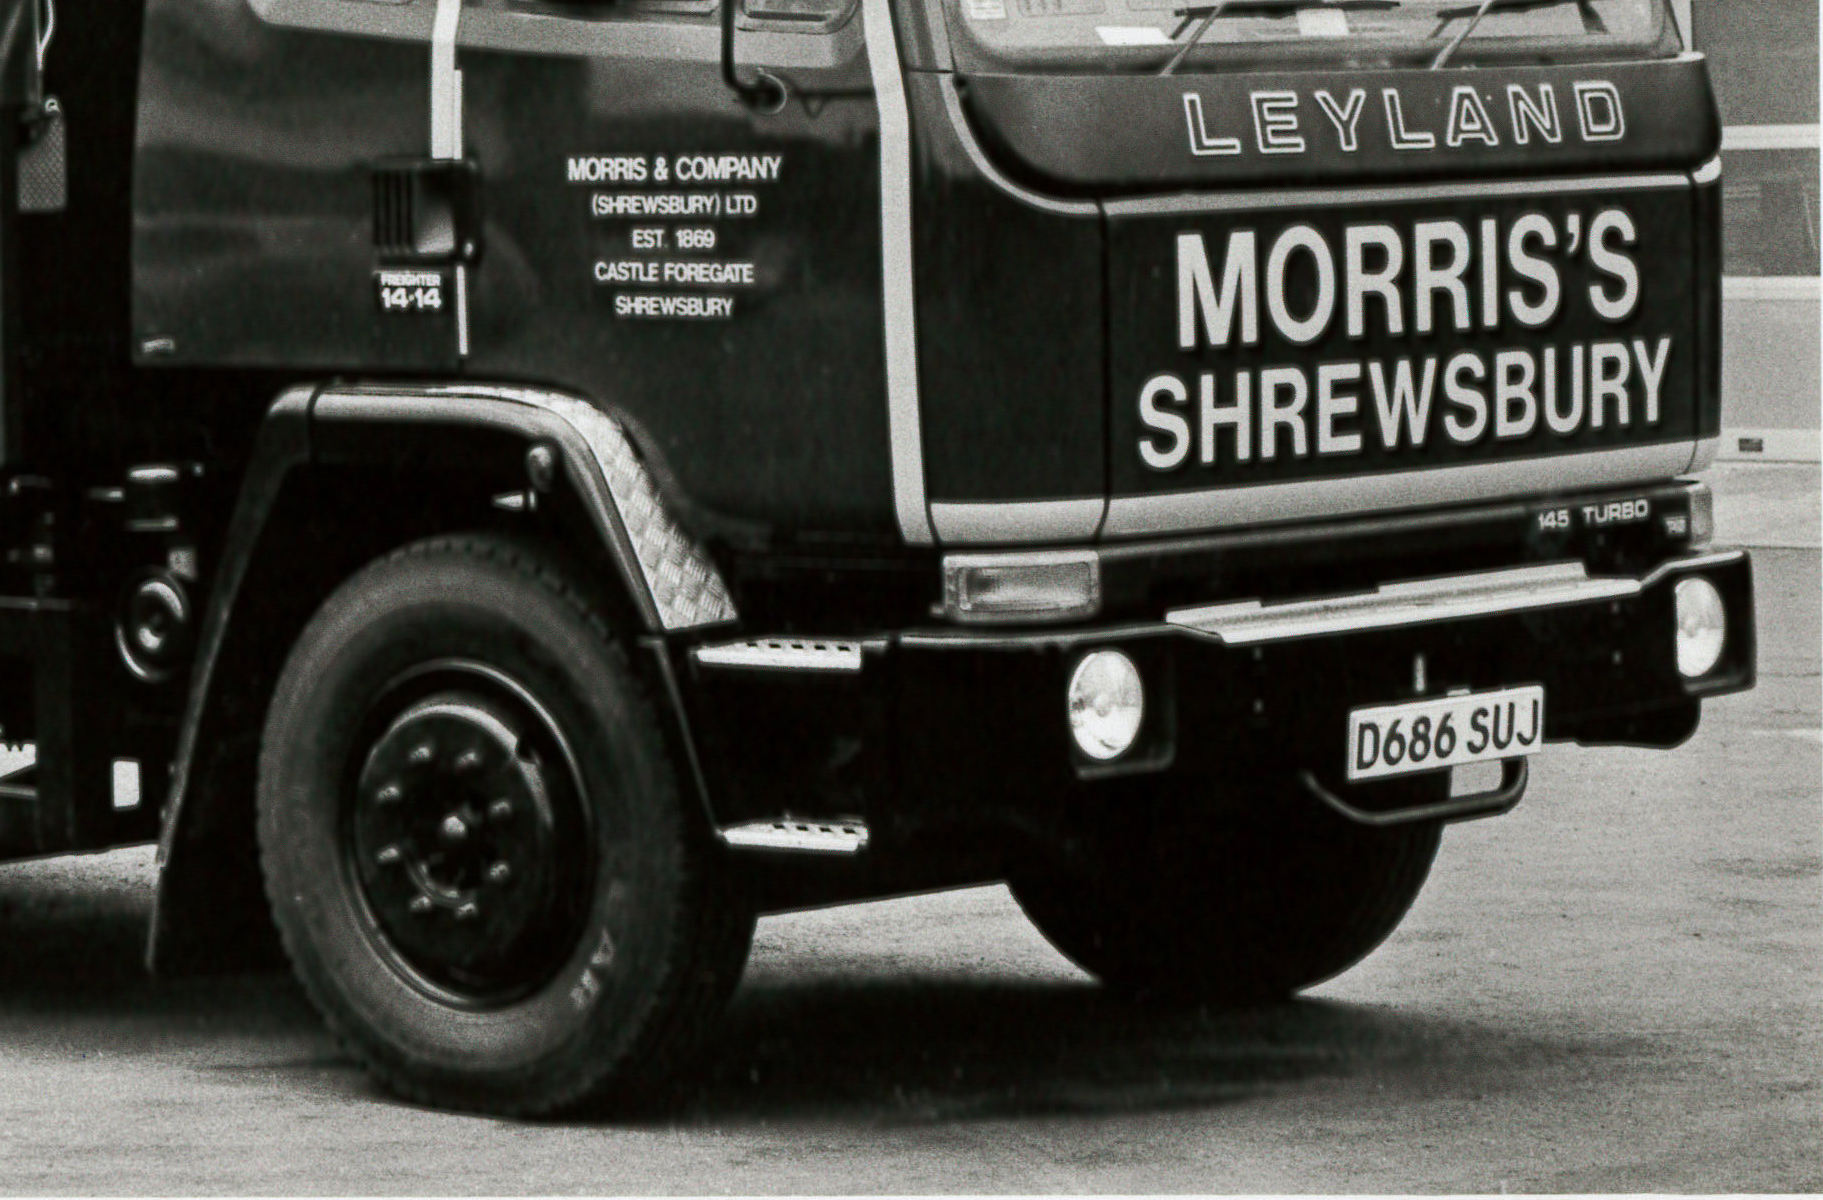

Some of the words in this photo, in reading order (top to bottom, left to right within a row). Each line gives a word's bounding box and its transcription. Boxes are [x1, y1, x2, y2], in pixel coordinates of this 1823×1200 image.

[1183, 79, 1626, 156] LEYLAND
[567, 156, 648, 182] MORRIS
[653, 156, 669, 181] &
[675, 155, 782, 181] COMPANY
[591, 193, 721, 216] (SHREWSBURY)
[725, 194, 758, 215] LTD
[675, 228, 716, 249] 1869
[594, 261, 659, 283] CASTLE
[663, 262, 755, 284] FOREGATE
[1176, 209, 1640, 349] MORRIS'S
[615, 295, 733, 317] SHREWSBURY
[1138, 336, 1671, 470] SHREWSBURY
[1537, 509, 1570, 530] 145
[1582, 498, 1649, 524] TURBO
[1355, 712, 1457, 771] D686
[1466, 698, 1540, 755] SUJ
